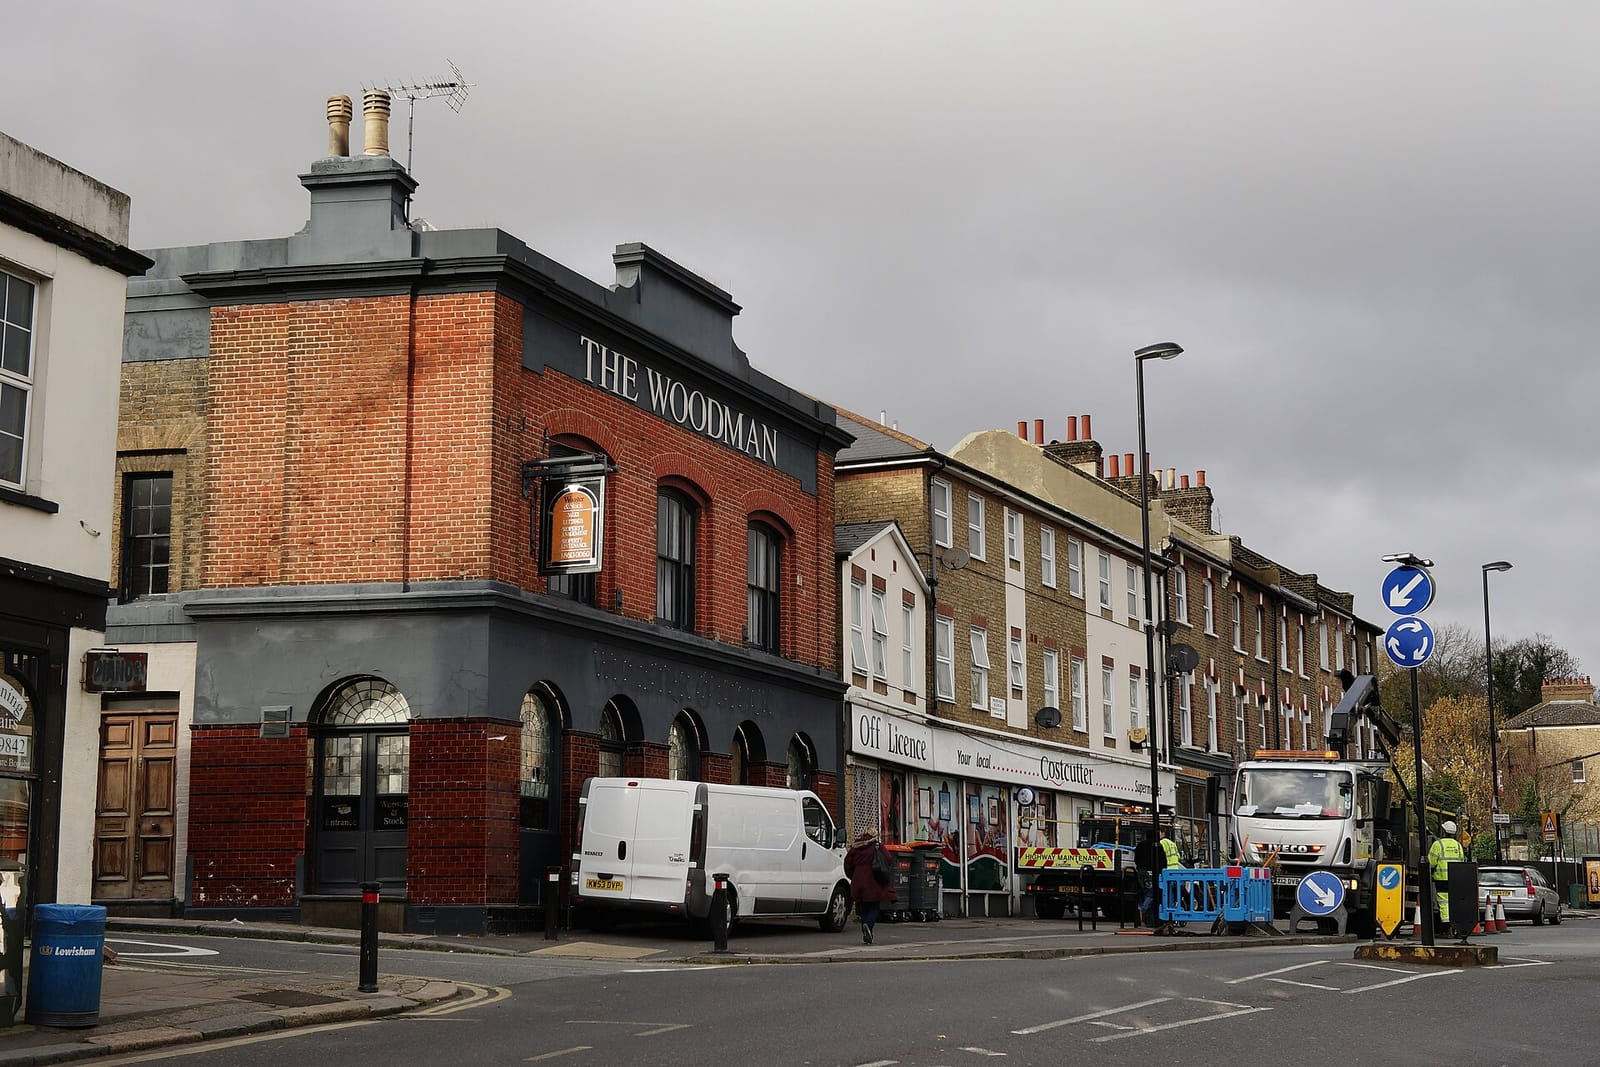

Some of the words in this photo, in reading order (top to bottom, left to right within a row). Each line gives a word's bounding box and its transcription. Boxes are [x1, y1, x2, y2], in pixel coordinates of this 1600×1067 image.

[580, 335, 639, 402] THE
[645, 366, 778, 467] WOODMAN
[860, 714, 881, 750] Off
[888, 722, 927, 761] Licence
[957, 749, 972, 766] Your
[976, 752, 992, 770] local
[1040, 755, 1094, 786] Costcutter
[383, 817, 405, 825] Stock
[1025, 853, 1055, 861] HIGHWAY
[1057, 854, 1107, 862] MAINTENANCE
[1268, 844, 1308, 853] IVECO
